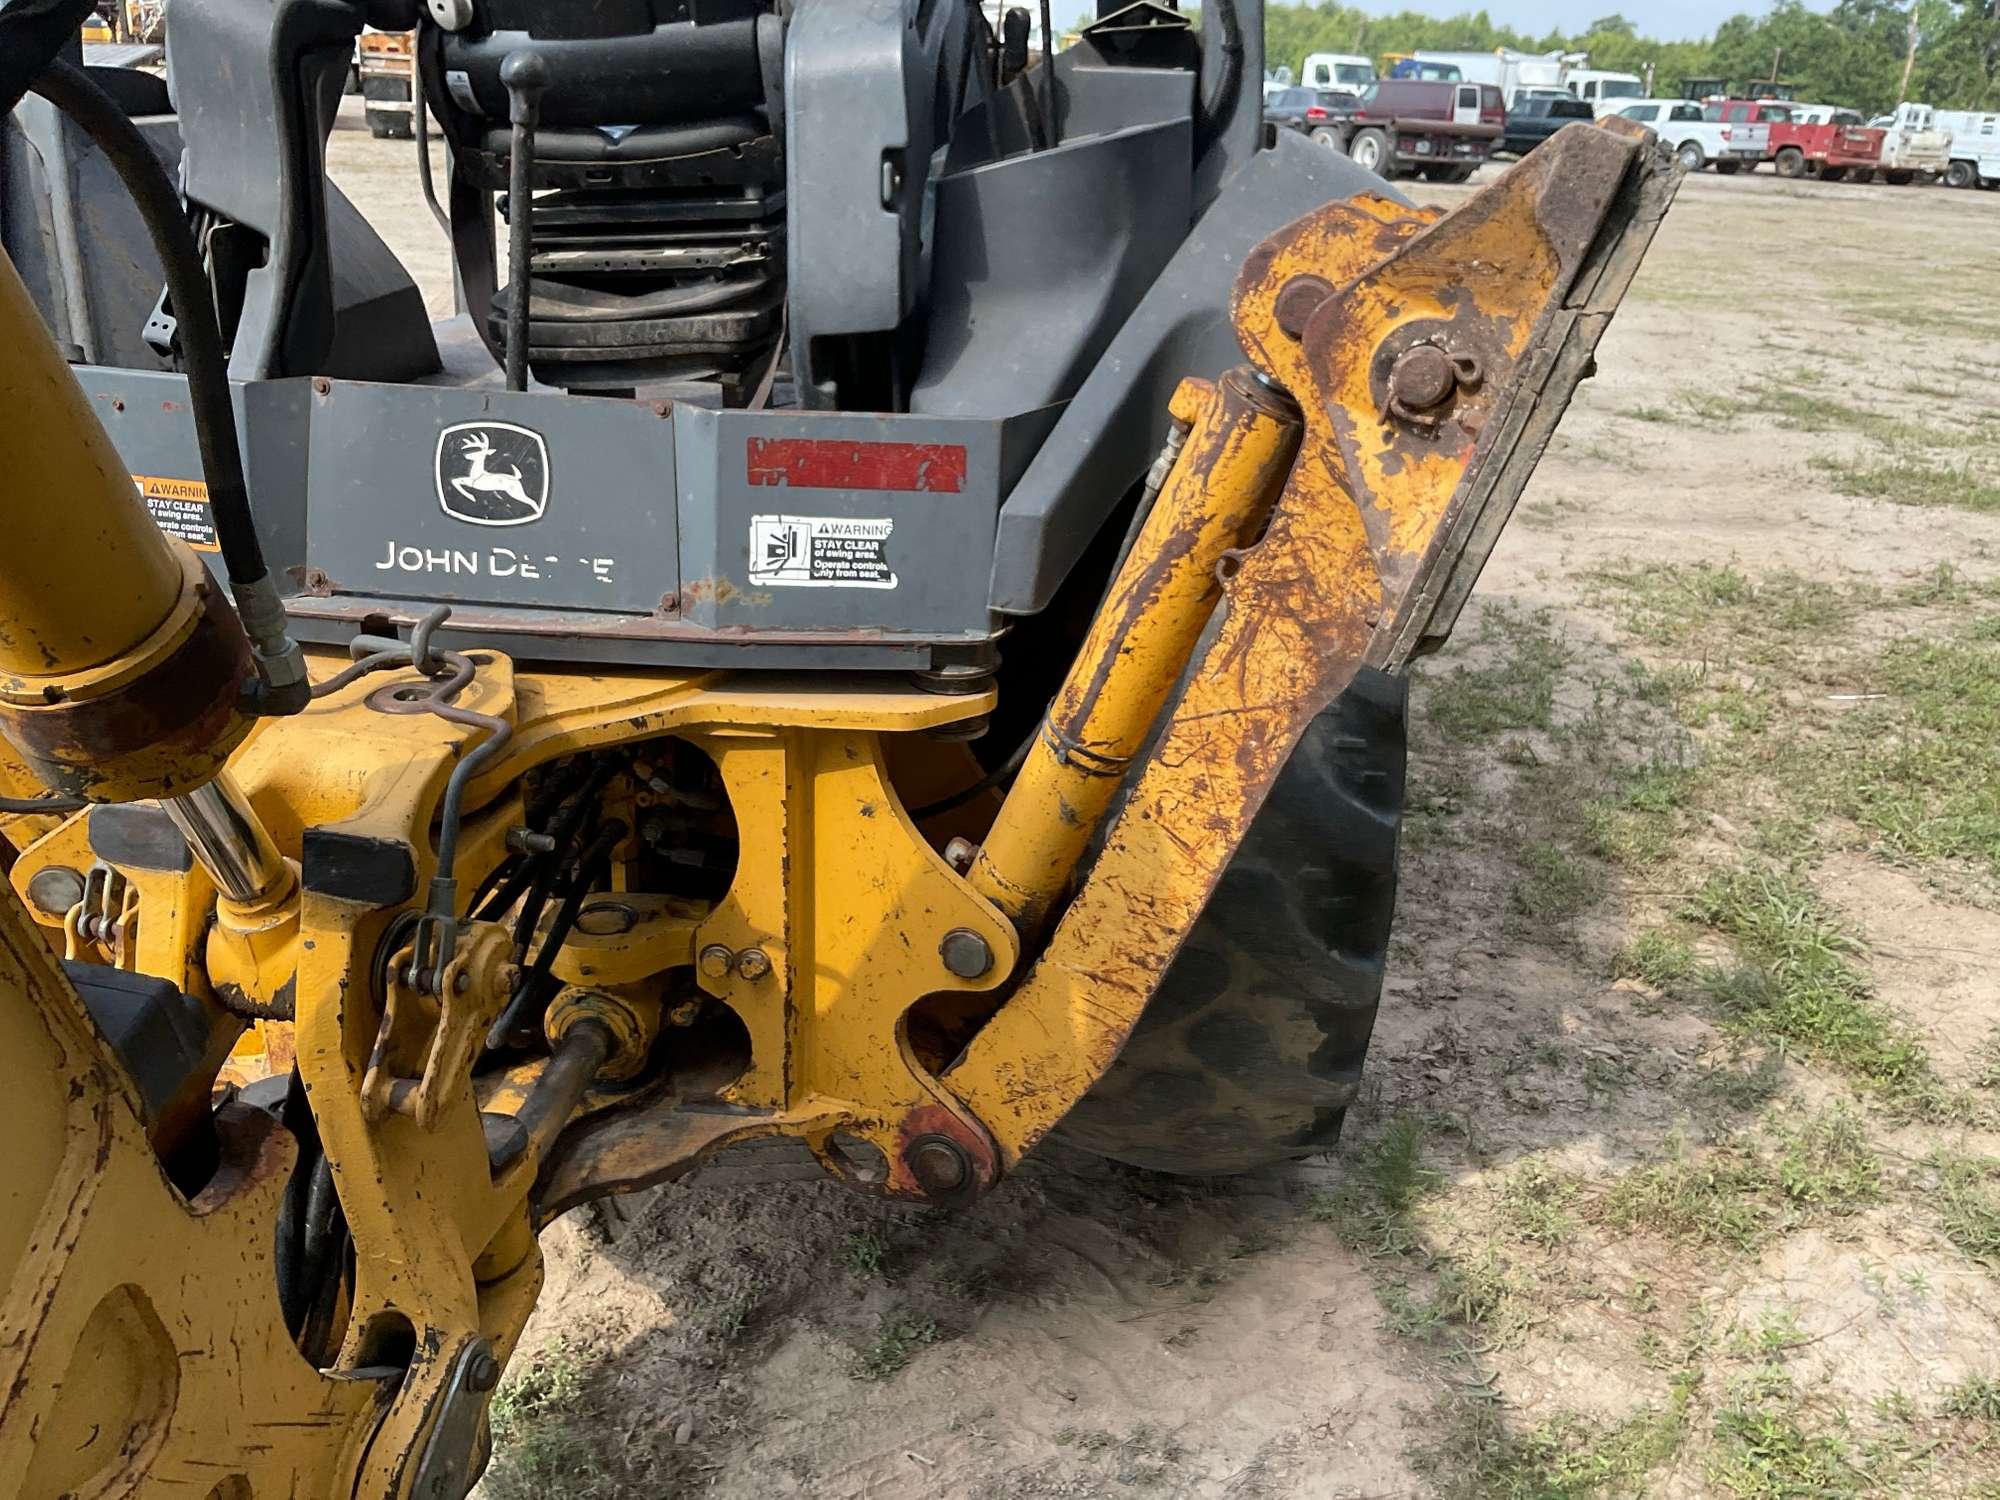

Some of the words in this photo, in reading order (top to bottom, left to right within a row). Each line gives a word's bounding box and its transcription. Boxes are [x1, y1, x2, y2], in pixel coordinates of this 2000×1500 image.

[160, 484, 207, 499] WARNIN
[147, 498, 171, 510] STAY
[173, 499, 204, 513] CLEAR
[157, 509, 182, 520] swing
[181, 521, 213, 534] controls
[814, 539, 843, 549] STAY
[844, 540, 879, 551] CLEAR
[814, 549, 825, 557] of
[826, 549, 853, 560] swing
[855, 551, 877, 560] area.
[375, 541, 478, 575] JOHN
[489, 547, 614, 583] DEE
[814, 559, 850, 570] Operate
[835, 568, 858, 577] from
